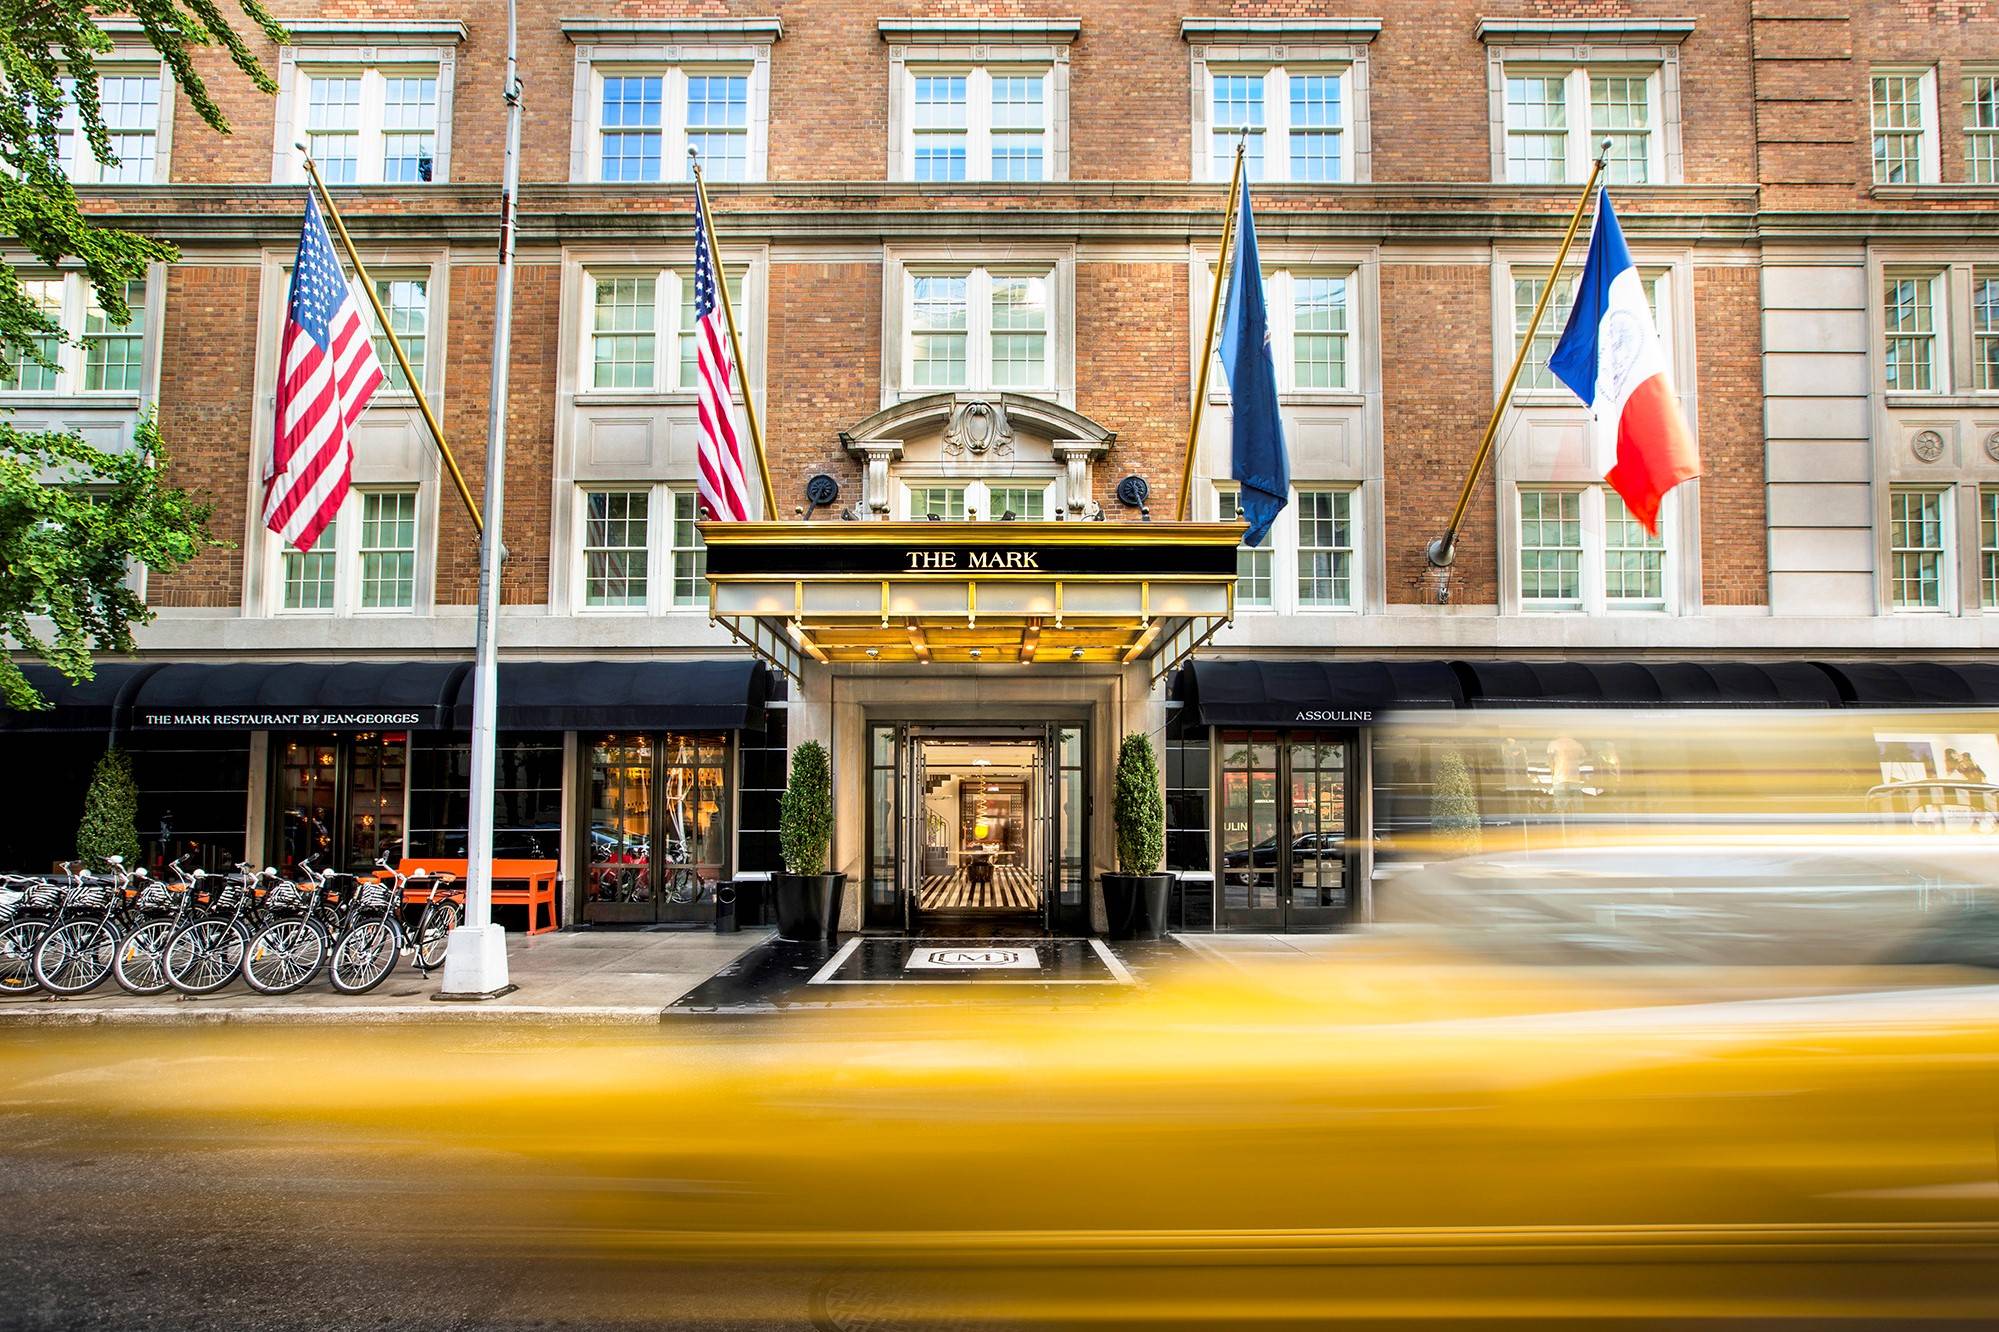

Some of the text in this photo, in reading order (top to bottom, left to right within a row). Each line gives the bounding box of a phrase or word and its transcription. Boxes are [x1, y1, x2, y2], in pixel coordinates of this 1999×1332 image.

[905, 551, 1039, 568] THE MARK
[145, 713, 420, 725] THE MARK RESTAURANT BY JEAN-GEORGES
[1295, 710, 1373, 721] ASSOULINE
